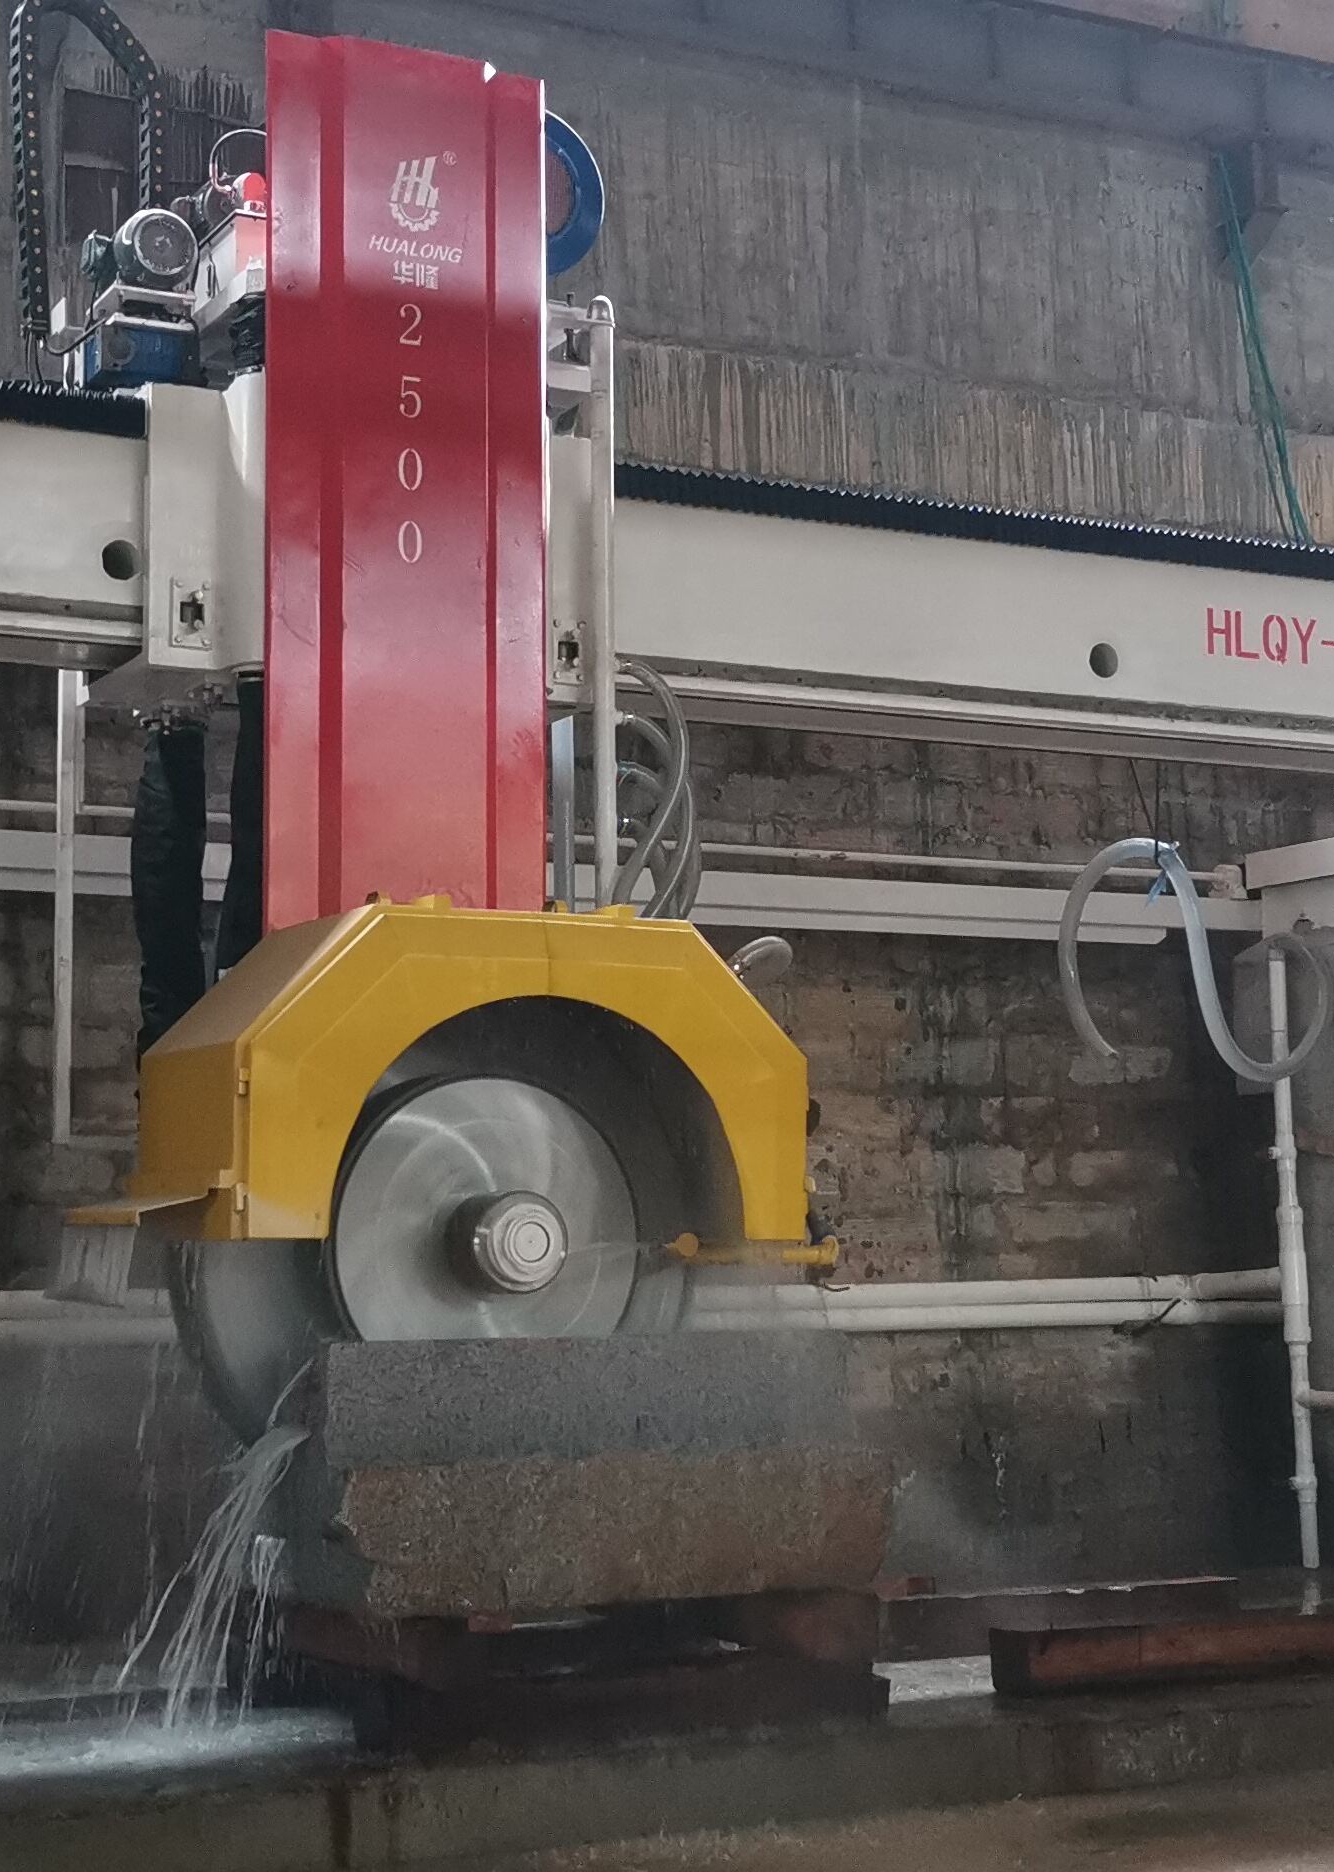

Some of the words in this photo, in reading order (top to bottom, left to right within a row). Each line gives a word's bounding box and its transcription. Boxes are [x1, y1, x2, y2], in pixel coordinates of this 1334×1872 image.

[369, 234, 463, 264] HUALONG
[392, 260, 439, 290] 华隆
[398, 303, 424, 564] 2500
